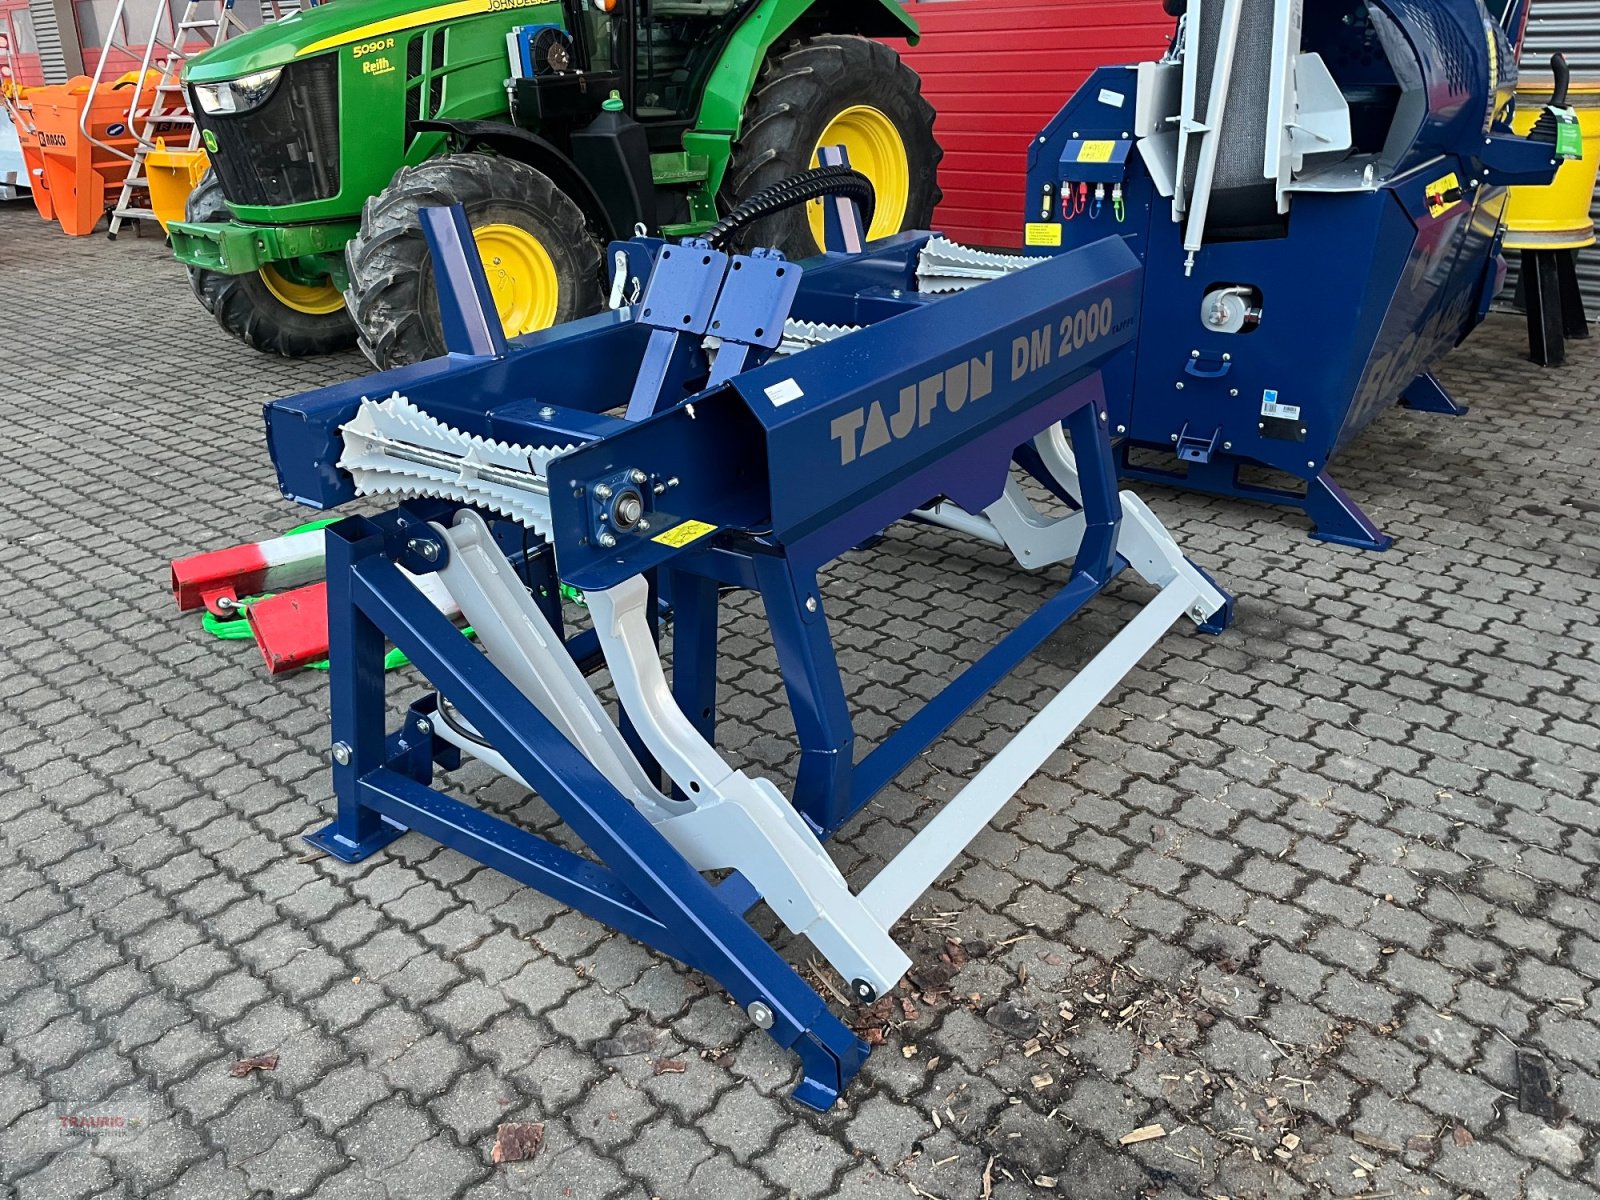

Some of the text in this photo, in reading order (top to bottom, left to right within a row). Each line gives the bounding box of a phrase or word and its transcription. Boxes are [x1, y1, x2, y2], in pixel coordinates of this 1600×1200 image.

[488, 0, 515, 10] JOHN
[353, 38, 394, 58] 5090 R
[362, 57, 390, 74] Reith
[45, 133, 66, 146] RASCO
[830, 297, 1113, 466] TAJFUN DM 2000
